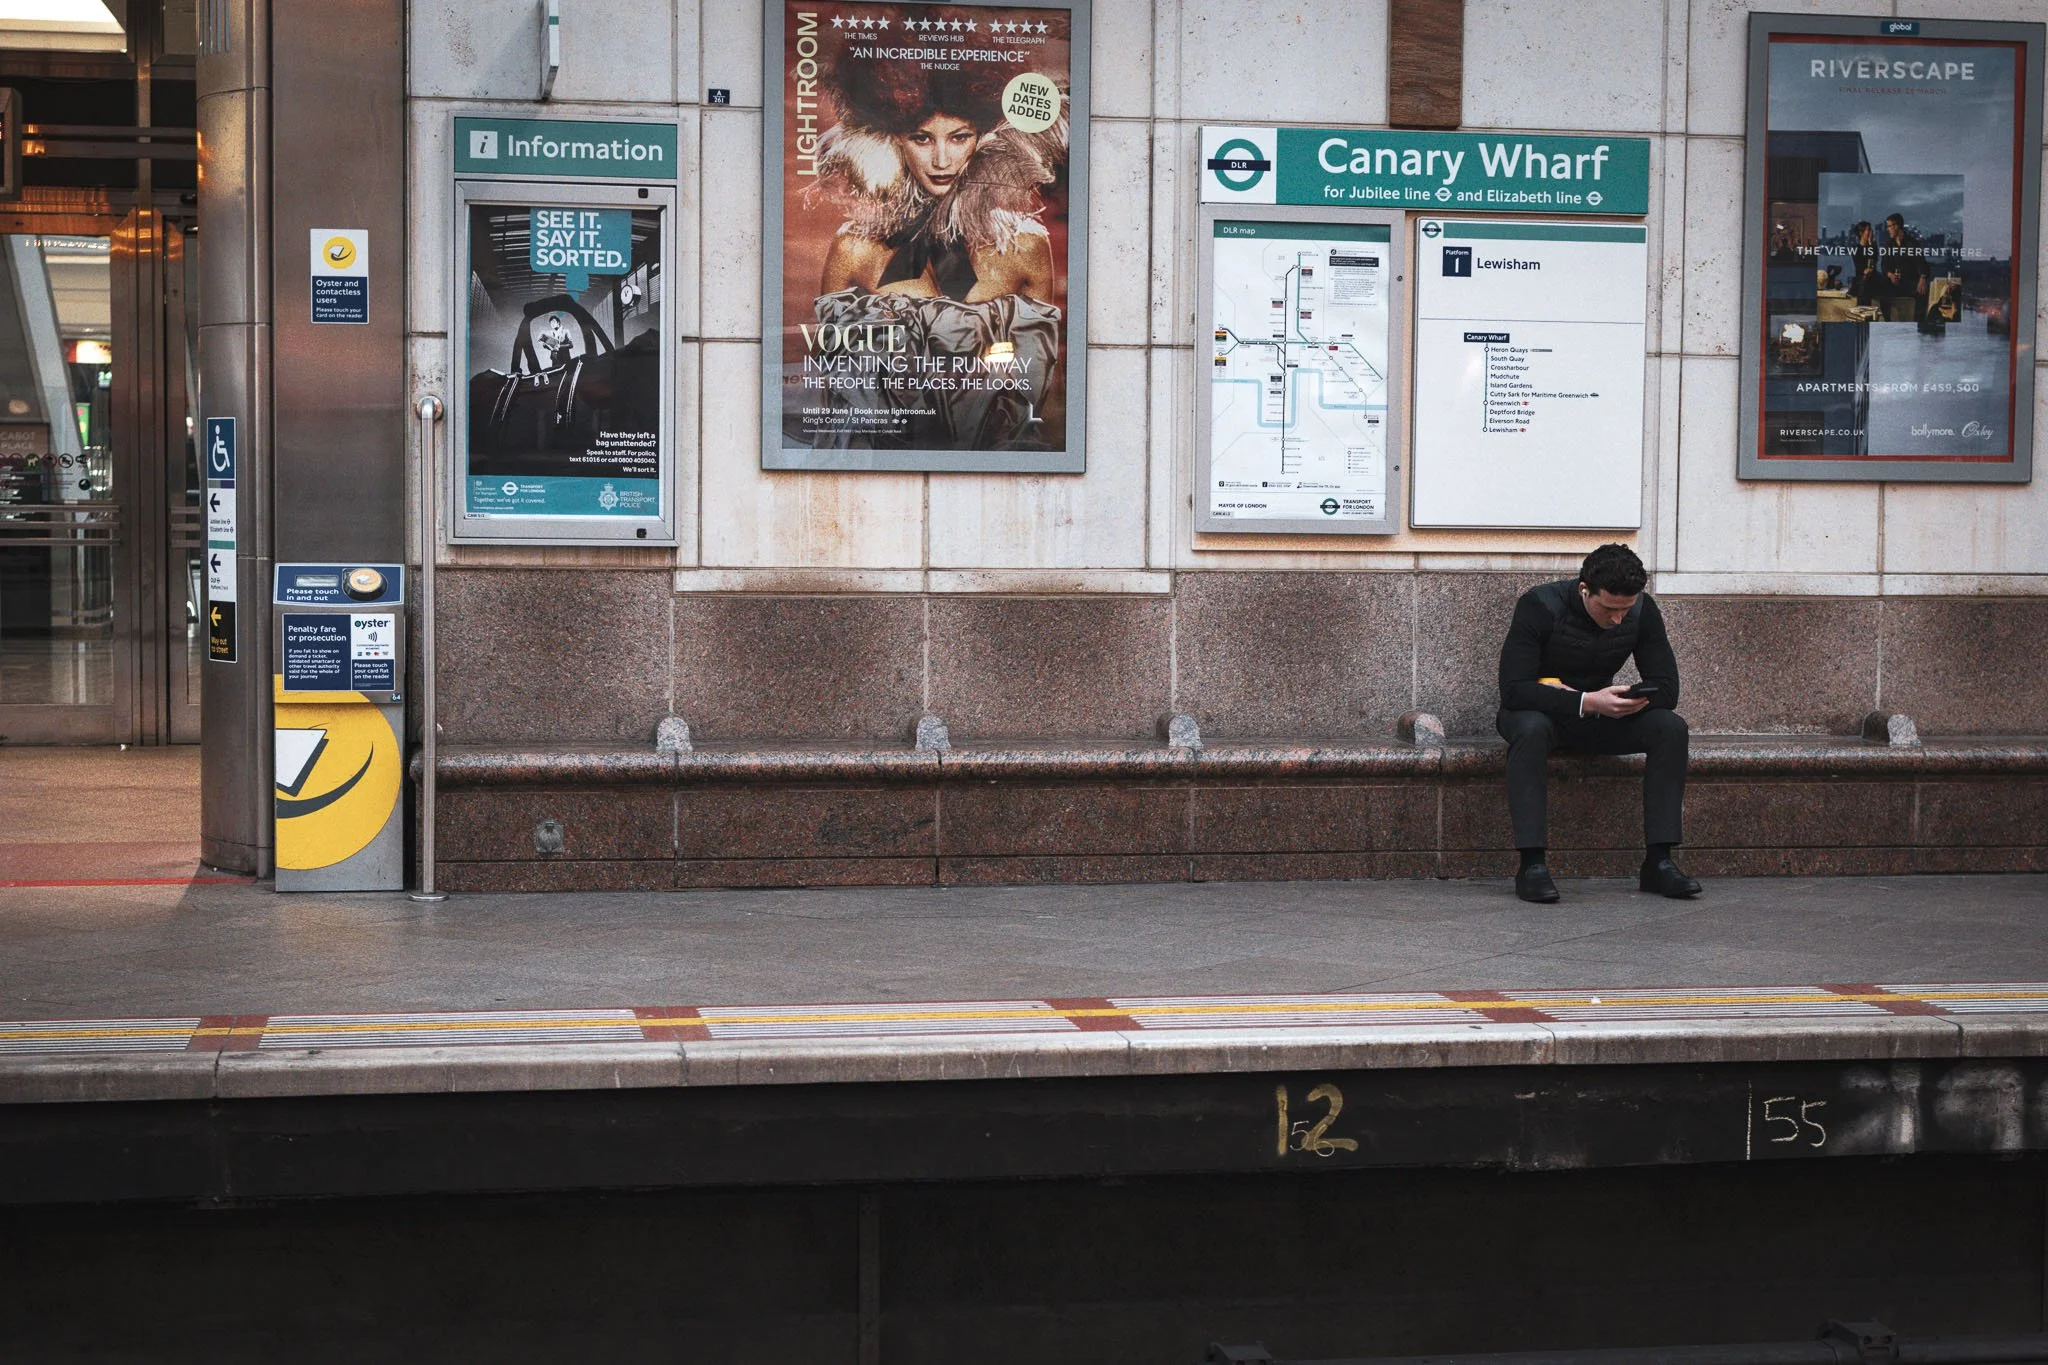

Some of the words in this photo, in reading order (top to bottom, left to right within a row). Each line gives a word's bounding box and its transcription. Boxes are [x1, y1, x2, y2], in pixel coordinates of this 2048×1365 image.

[1890, 23, 1911, 32] global
[844, 32, 856, 40] THE
[876, 49, 947, 60] INCREDIBLE
[935, 63, 959, 71] NUDGE
[1811, 60, 1975, 80] RIVERSCAPE
[797, 12, 817, 176] LIGHTROOM
[1020, 82, 1048, 96] NEW
[1013, 93, 1051, 109] DATES
[1008, 104, 1051, 121] ADDED
[508, 135, 663, 161] Information
[1318, 137, 1465, 185] Canary
[1478, 142, 1609, 181] Wharf
[1324, 185, 1345, 198] for
[1349, 186, 1400, 200] Jubilee
[1405, 187, 1431, 200] line
[1457, 189, 1482, 202] and
[1487, 190, 1551, 204] Elizabeth
[1556, 191, 1582, 204] line
[536, 211, 574, 229] SEE
[580, 212, 601, 229] IT.
[536, 230, 575, 247] SAY
[580, 231, 601, 248] IT.
[536, 249, 626, 268] SORTED.
[1797, 246, 1820, 255] THE
[1826, 246, 1858, 255] VIEW
[1863, 247, 1873, 255] IS
[1879, 247, 1948, 257] DIFFERENT
[1455, 258, 1459, 273] 1
[1477, 258, 1540, 270] Lewisham
[800, 324, 906, 352] VOGUE
[803, 356, 908, 372] INVENTING
[913, 356, 946, 373] THE
[953, 357, 1031, 374] RUNWAY
[803, 377, 825, 389] THE
[829, 377, 879, 389] PEOPLE.
[883, 378, 904, 389] THE
[908, 378, 958, 390] PLACES.
[961, 378, 982, 390] THE
[986, 379, 1032, 390] LOOKS.
[1797, 383, 1879, 392] APARTMENTS
[1884, 383, 1918, 392] FROM
[891, 408, 936, 416] lightroom.uk
[620, 432, 636, 440] they
[288, 626, 318, 634] Penalty
[354, 619, 389, 630] oyster
[299, 634, 346, 642] prosecution
[1276, 1083, 1359, 1156] 12
